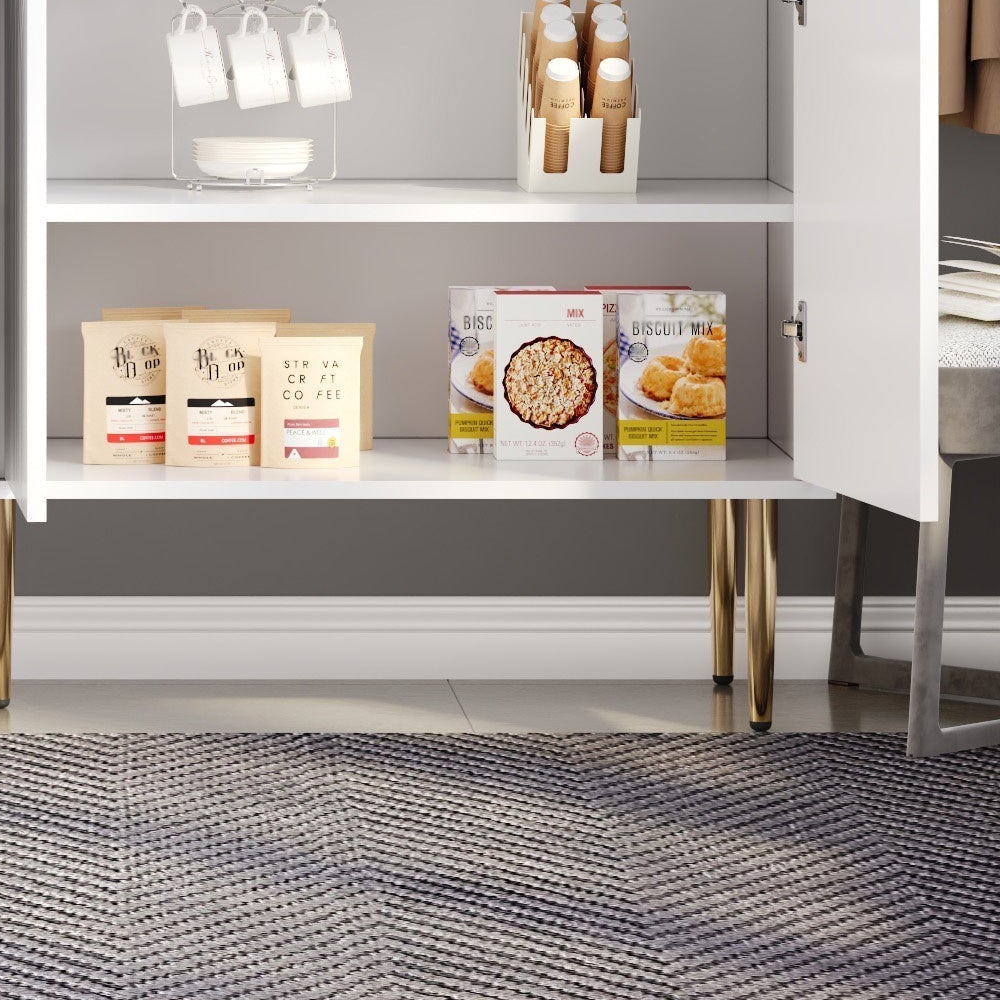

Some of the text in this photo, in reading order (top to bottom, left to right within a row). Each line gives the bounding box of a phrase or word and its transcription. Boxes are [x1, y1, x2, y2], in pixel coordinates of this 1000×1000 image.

[550, 101, 575, 109] COFFEE
[602, 101, 627, 109] COFFEE
[566, 308, 584, 318] MIX
[603, 303, 617, 313] PIZ
[632, 320, 714, 336] BISCUIT MIX
